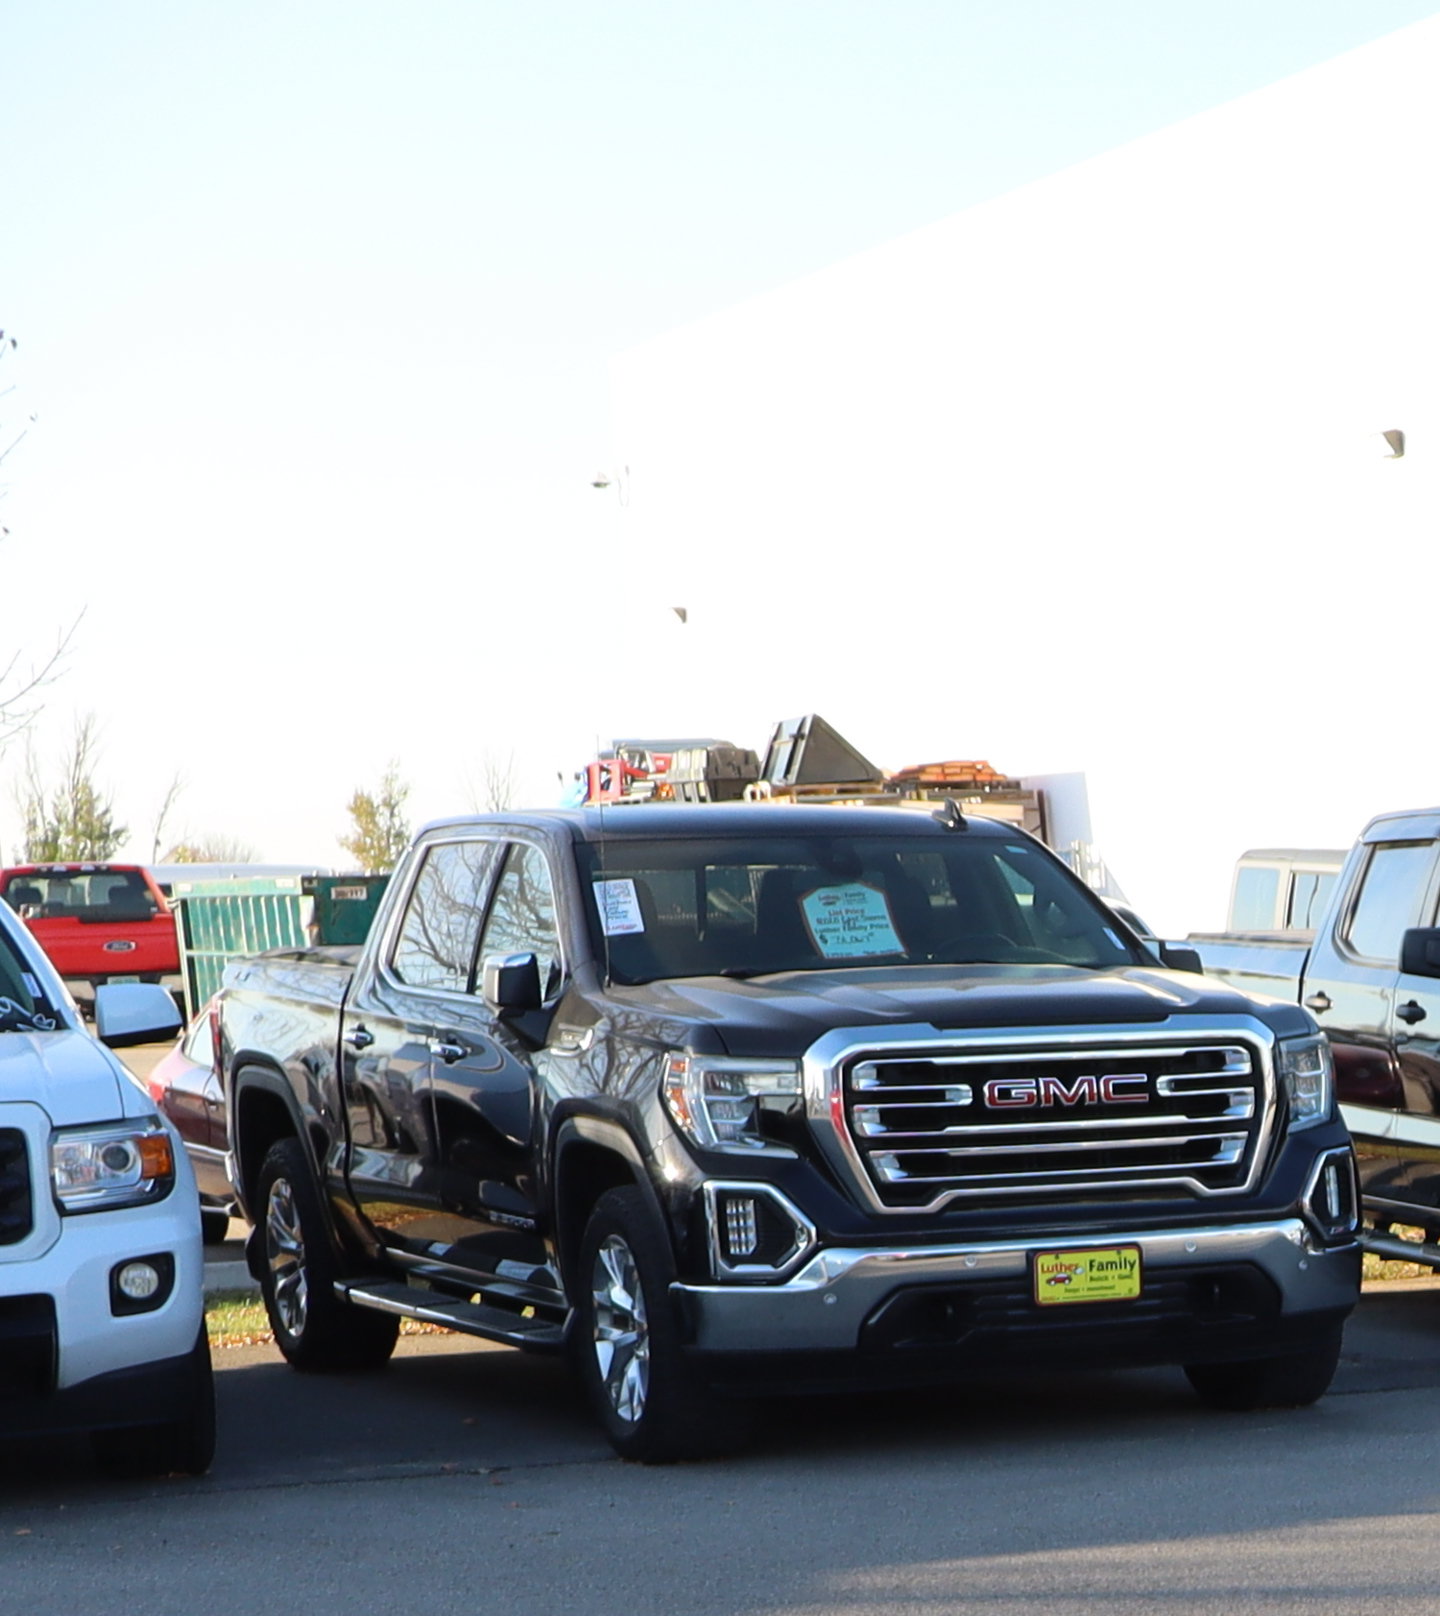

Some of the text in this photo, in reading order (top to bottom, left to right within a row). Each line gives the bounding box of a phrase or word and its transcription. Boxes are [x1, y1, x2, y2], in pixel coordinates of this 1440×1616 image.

[983, 1074, 1149, 1108] GMC
[1041, 1257, 1136, 1273] Luther Family
